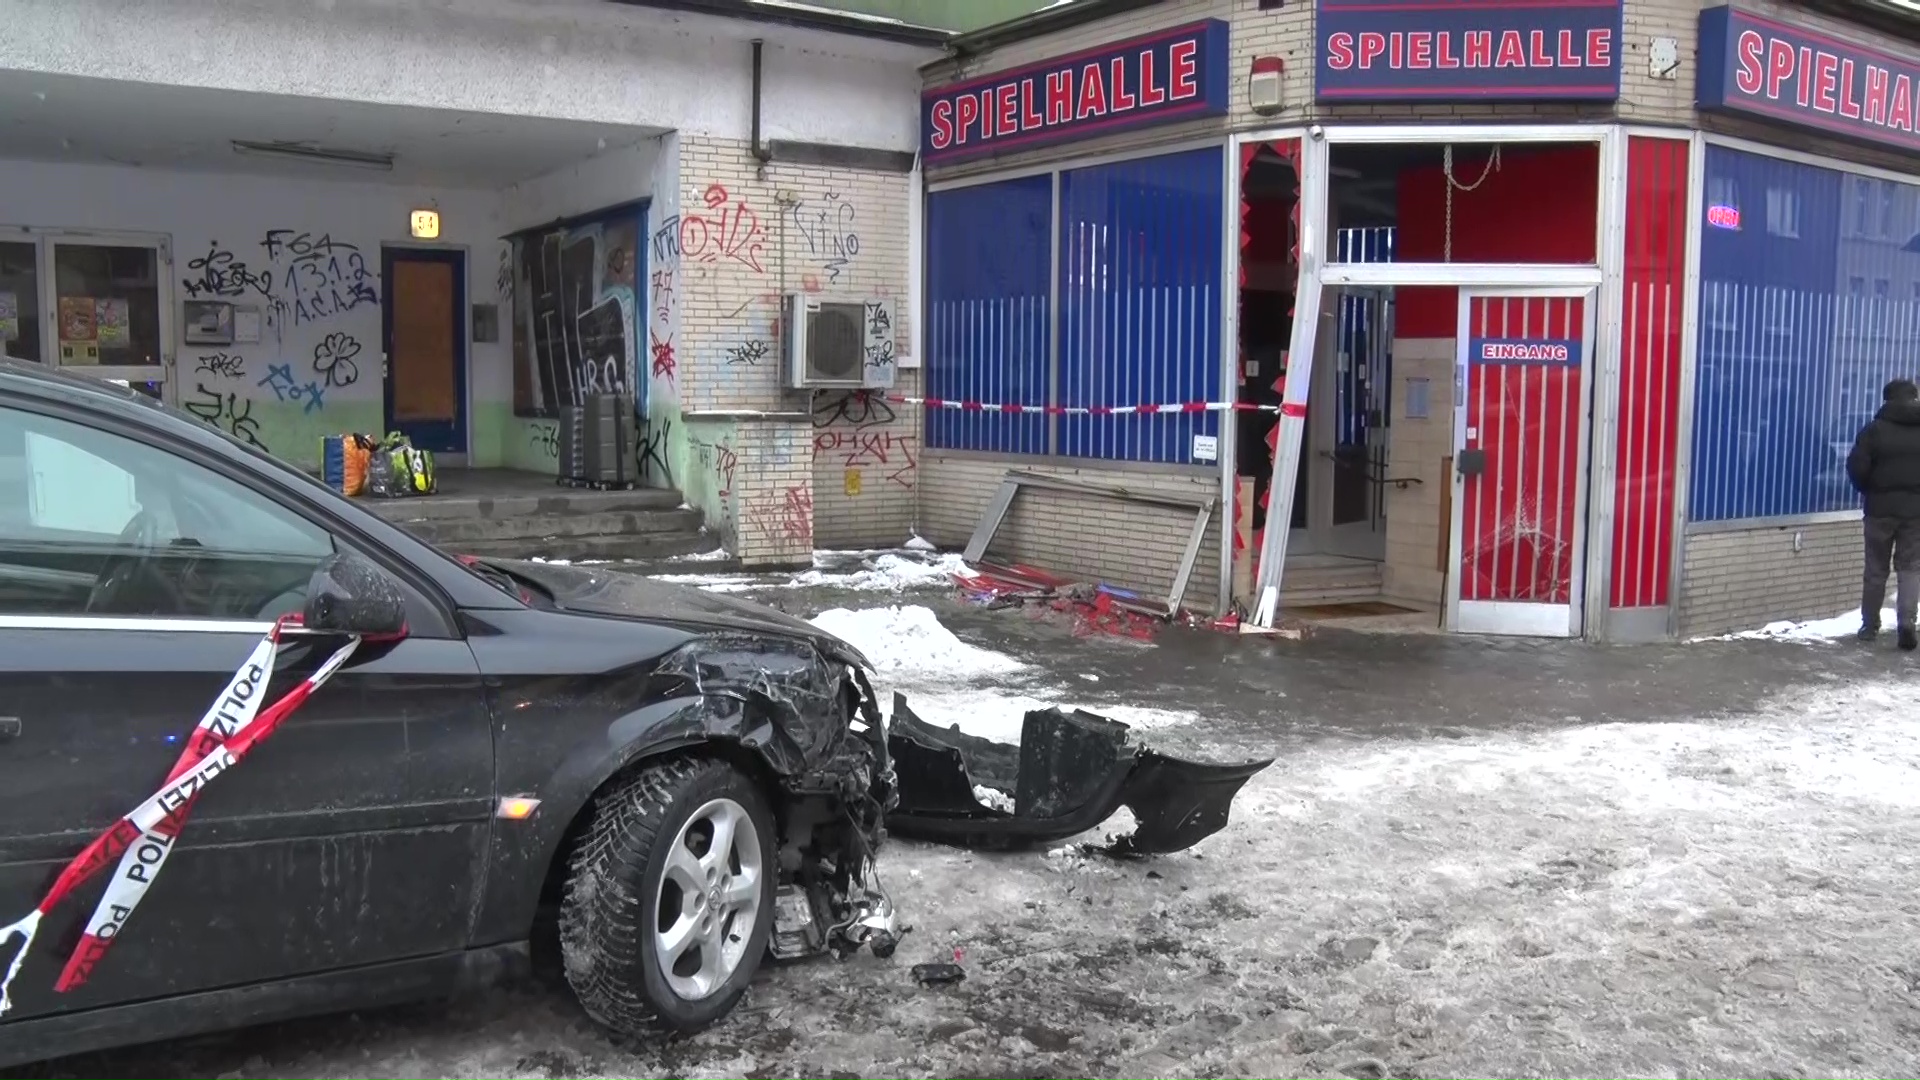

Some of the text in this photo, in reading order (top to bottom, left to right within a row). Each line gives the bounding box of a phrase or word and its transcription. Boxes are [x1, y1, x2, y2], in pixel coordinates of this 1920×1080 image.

[1327, 28, 1612, 70] SPIELHALLE
[930, 39, 1197, 149] SPIELHALLE
[418, 216, 434, 230] 54
[1482, 343, 1568, 361] EINGANG
